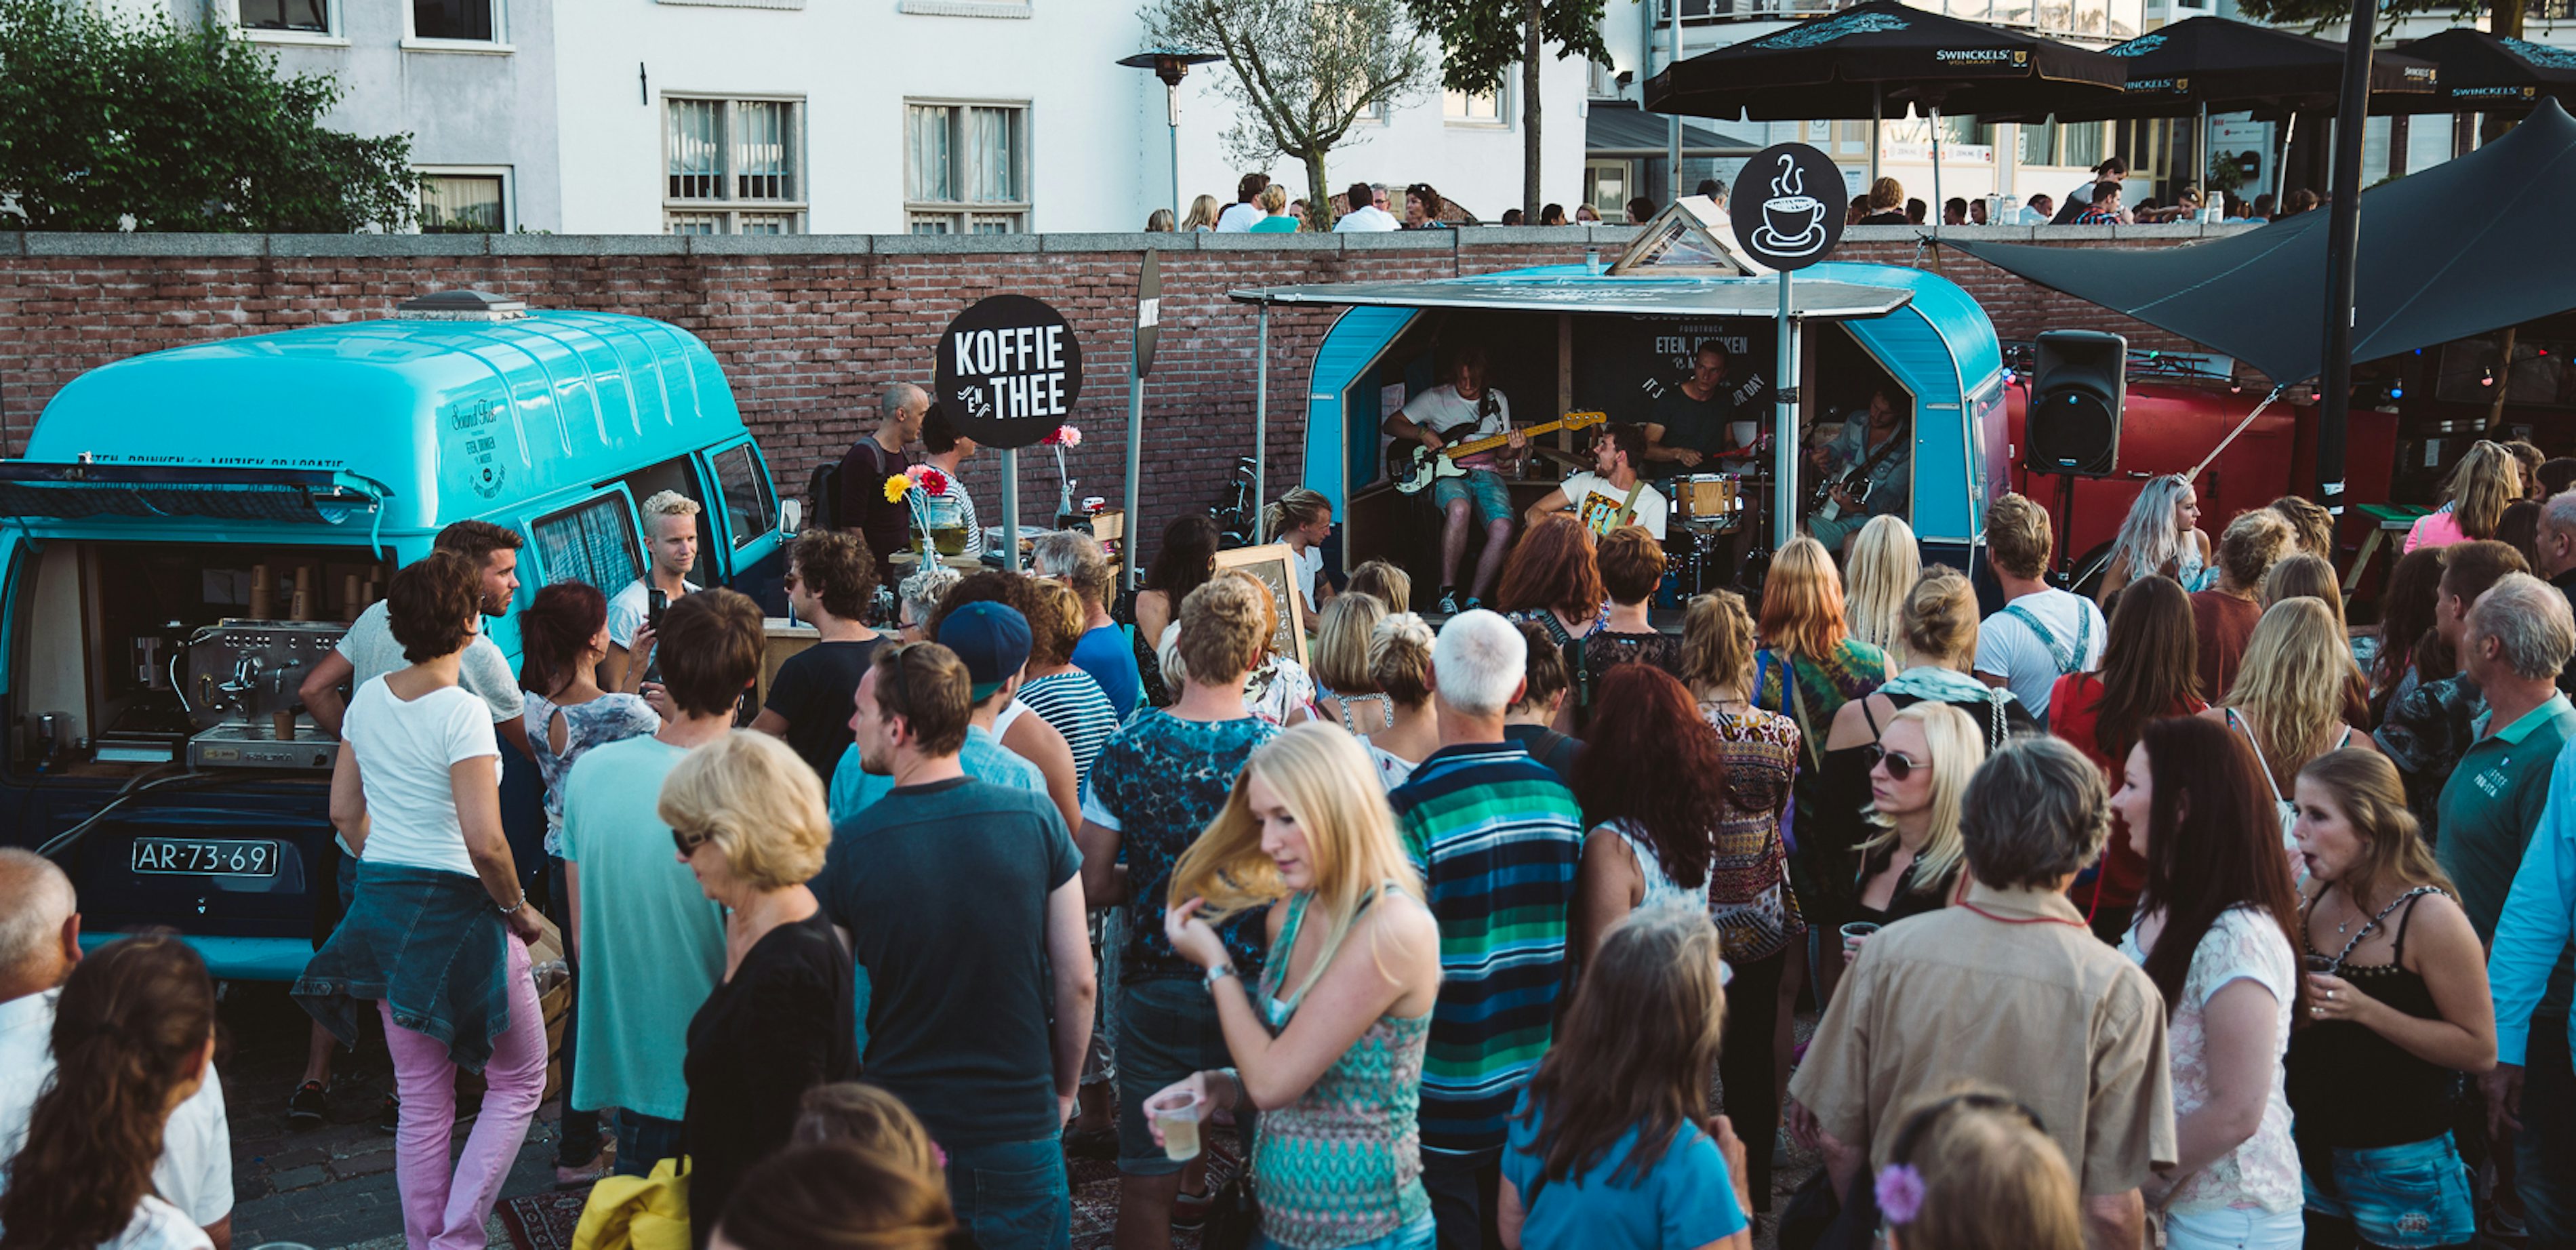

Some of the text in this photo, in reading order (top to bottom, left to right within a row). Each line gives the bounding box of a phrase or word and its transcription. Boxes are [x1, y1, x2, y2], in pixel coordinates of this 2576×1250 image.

[1679, 325, 1723, 333] FOODTRUCK
[954, 324, 1065, 376] KOFFIE
[1655, 336, 1690, 356] ETEN,
[989, 372, 1066, 419] THEE
[1743, 373, 1765, 397] DAY
[138, 843, 266, 871] AR-73-69
